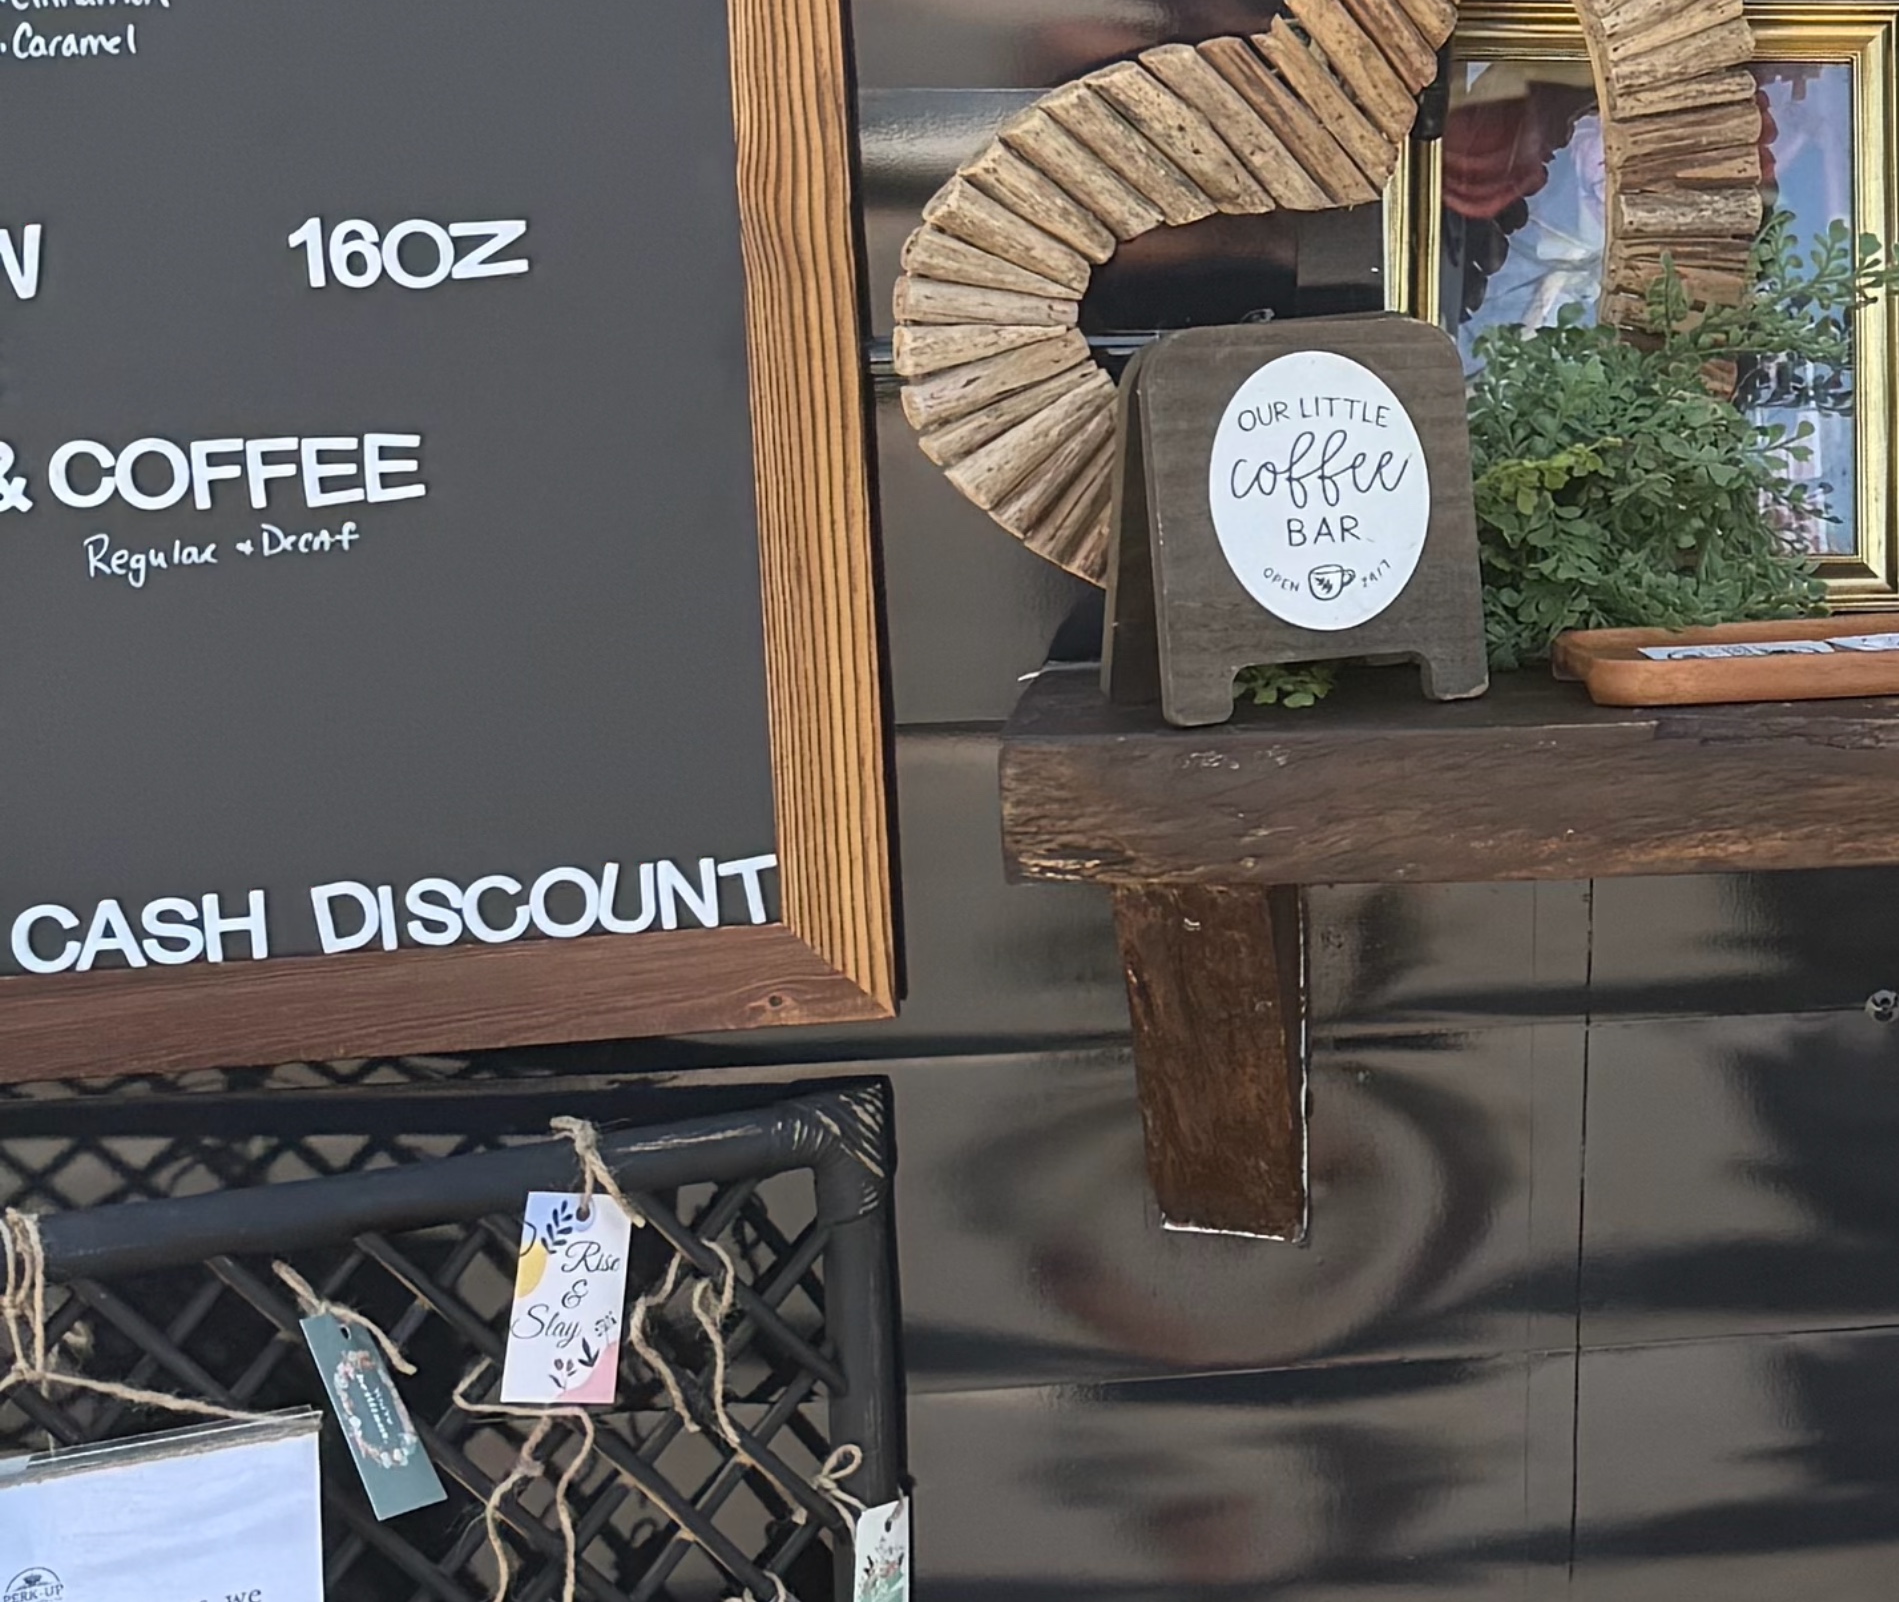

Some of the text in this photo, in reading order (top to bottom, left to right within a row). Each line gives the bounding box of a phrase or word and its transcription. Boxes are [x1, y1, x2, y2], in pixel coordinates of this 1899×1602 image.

[12, 23, 137, 59] Caramel
[288, 217, 530, 291] 16OZ
[1237, 396, 1392, 432] OUR LITTLE
[47, 433, 428, 511] COFFEE
[1230, 429, 1413, 508] coffee
[1286, 515, 1361, 547] BAR
[1263, 567, 1300, 592] OPEN
[10, 853, 780, 976] CASH DISCOUNT
[561, 1240, 621, 1273] Rise
[561, 1279, 589, 1309] &
